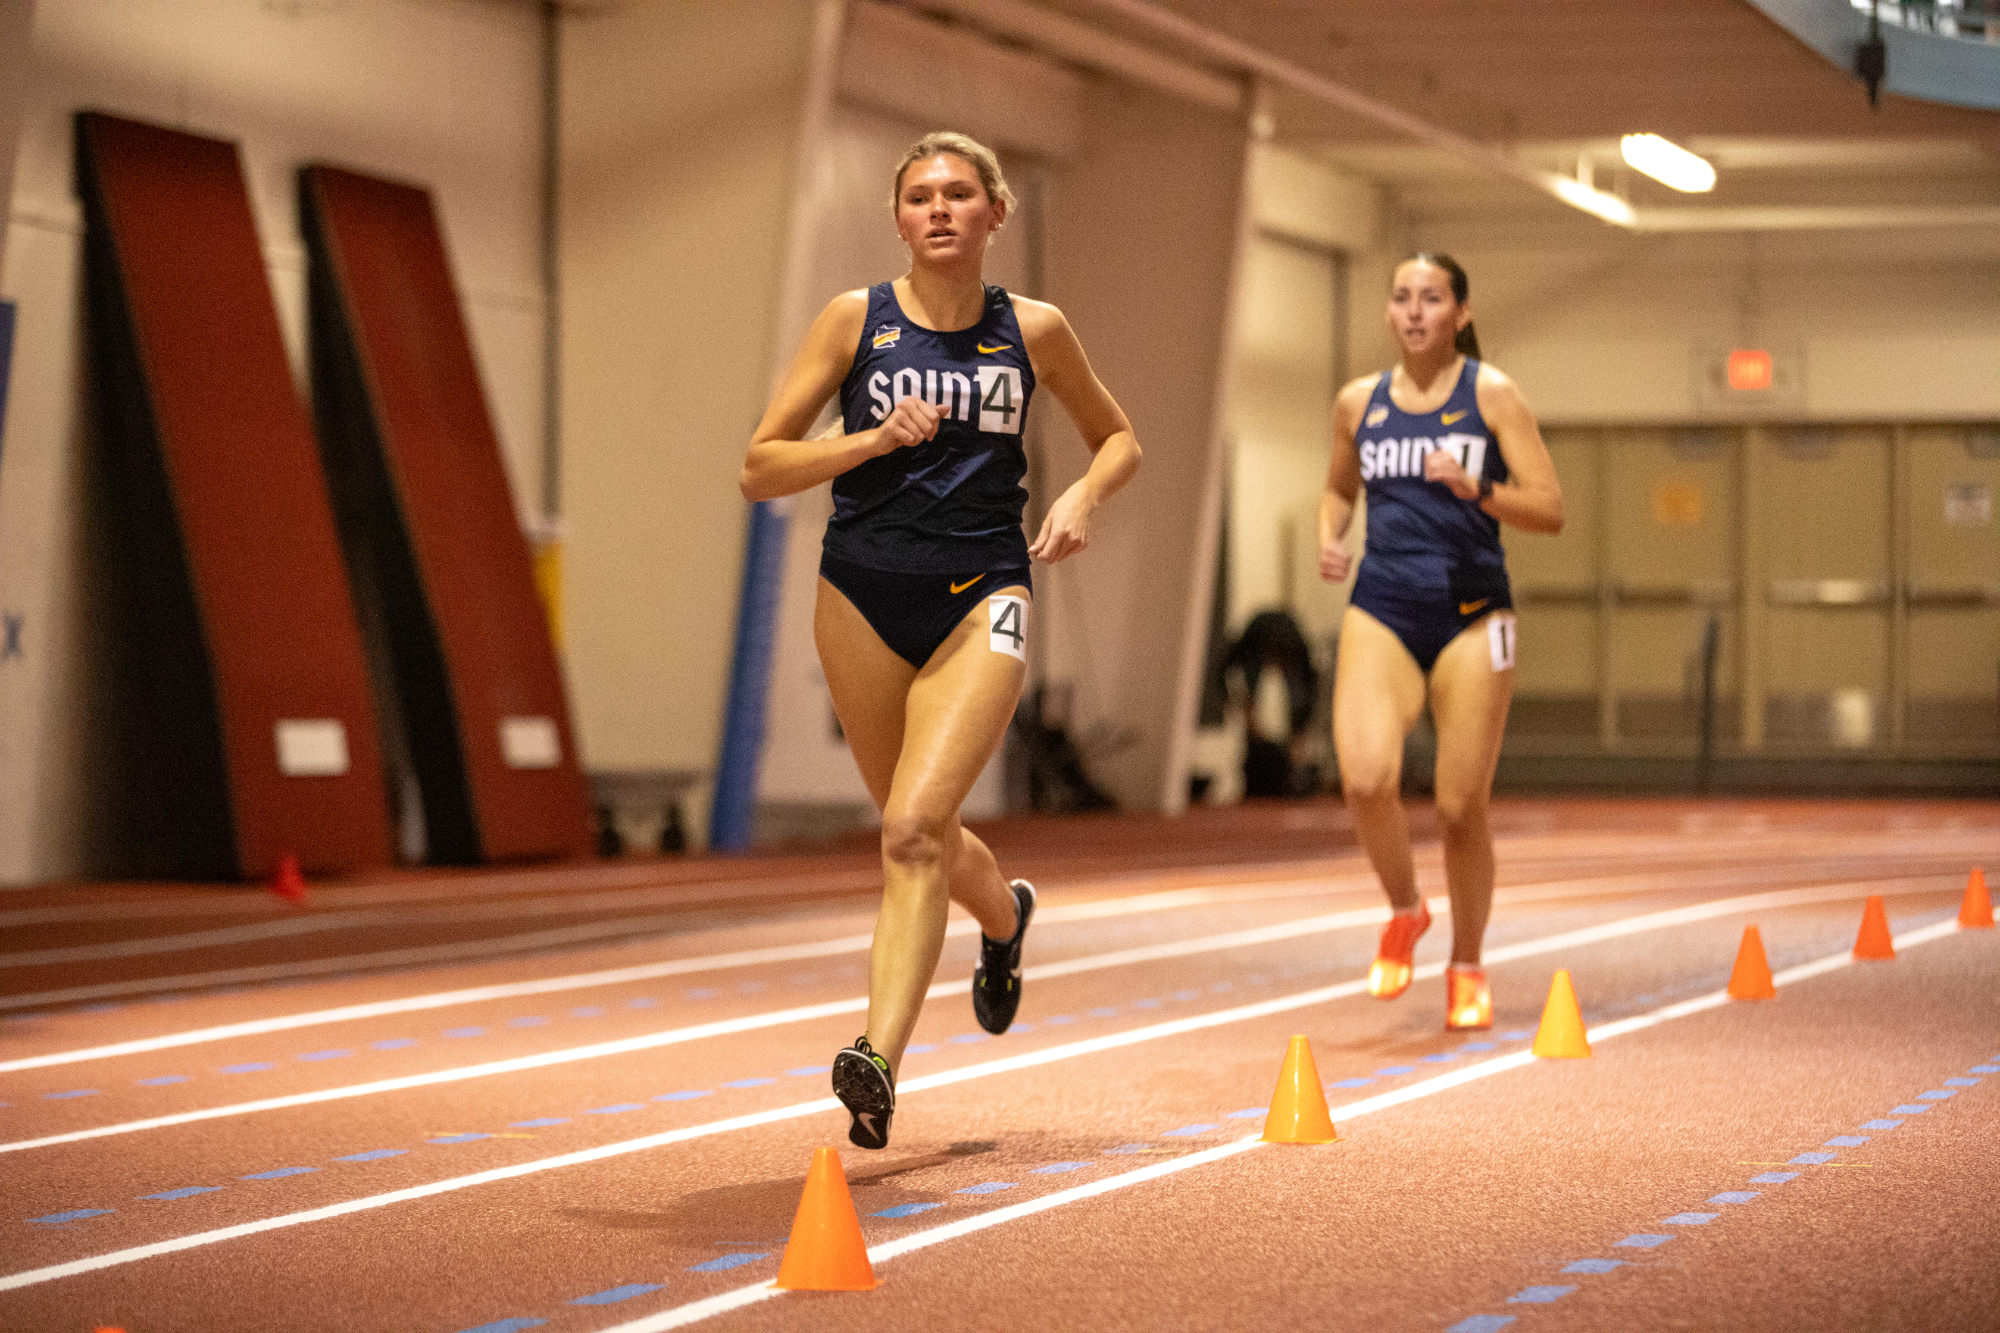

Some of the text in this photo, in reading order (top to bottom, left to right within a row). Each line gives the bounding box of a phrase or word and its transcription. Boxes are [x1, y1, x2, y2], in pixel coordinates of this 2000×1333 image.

[868, 367, 981, 421] SAIN
[981, 372, 1016, 425] 4
[1360, 436, 1448, 480] SAIN
[991, 601, 1024, 651] 4
